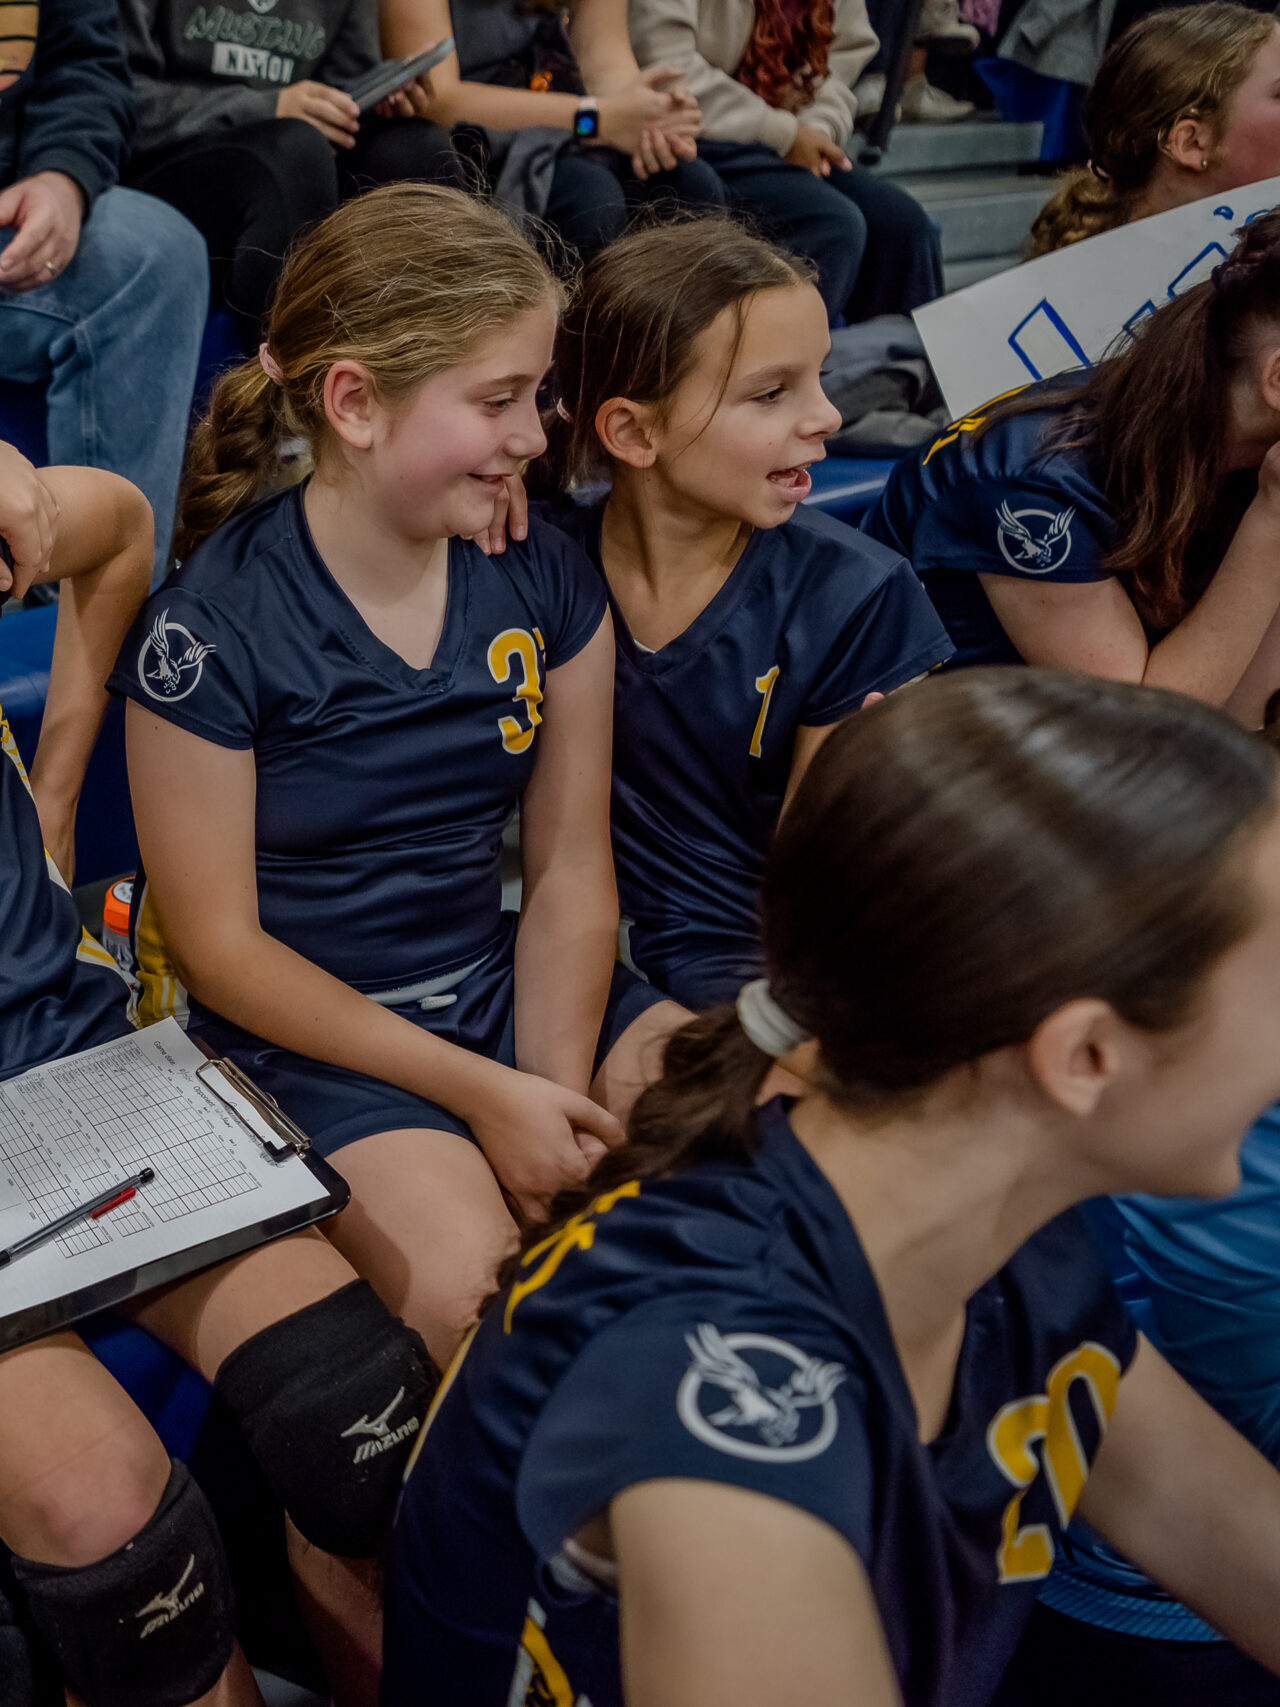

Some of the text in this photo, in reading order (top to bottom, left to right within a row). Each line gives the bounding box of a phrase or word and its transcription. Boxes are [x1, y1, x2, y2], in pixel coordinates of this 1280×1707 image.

[184, 5, 326, 60] MUSTANG
[487, 626, 547, 754] 3
[986, 1341, 1121, 1584] 20
